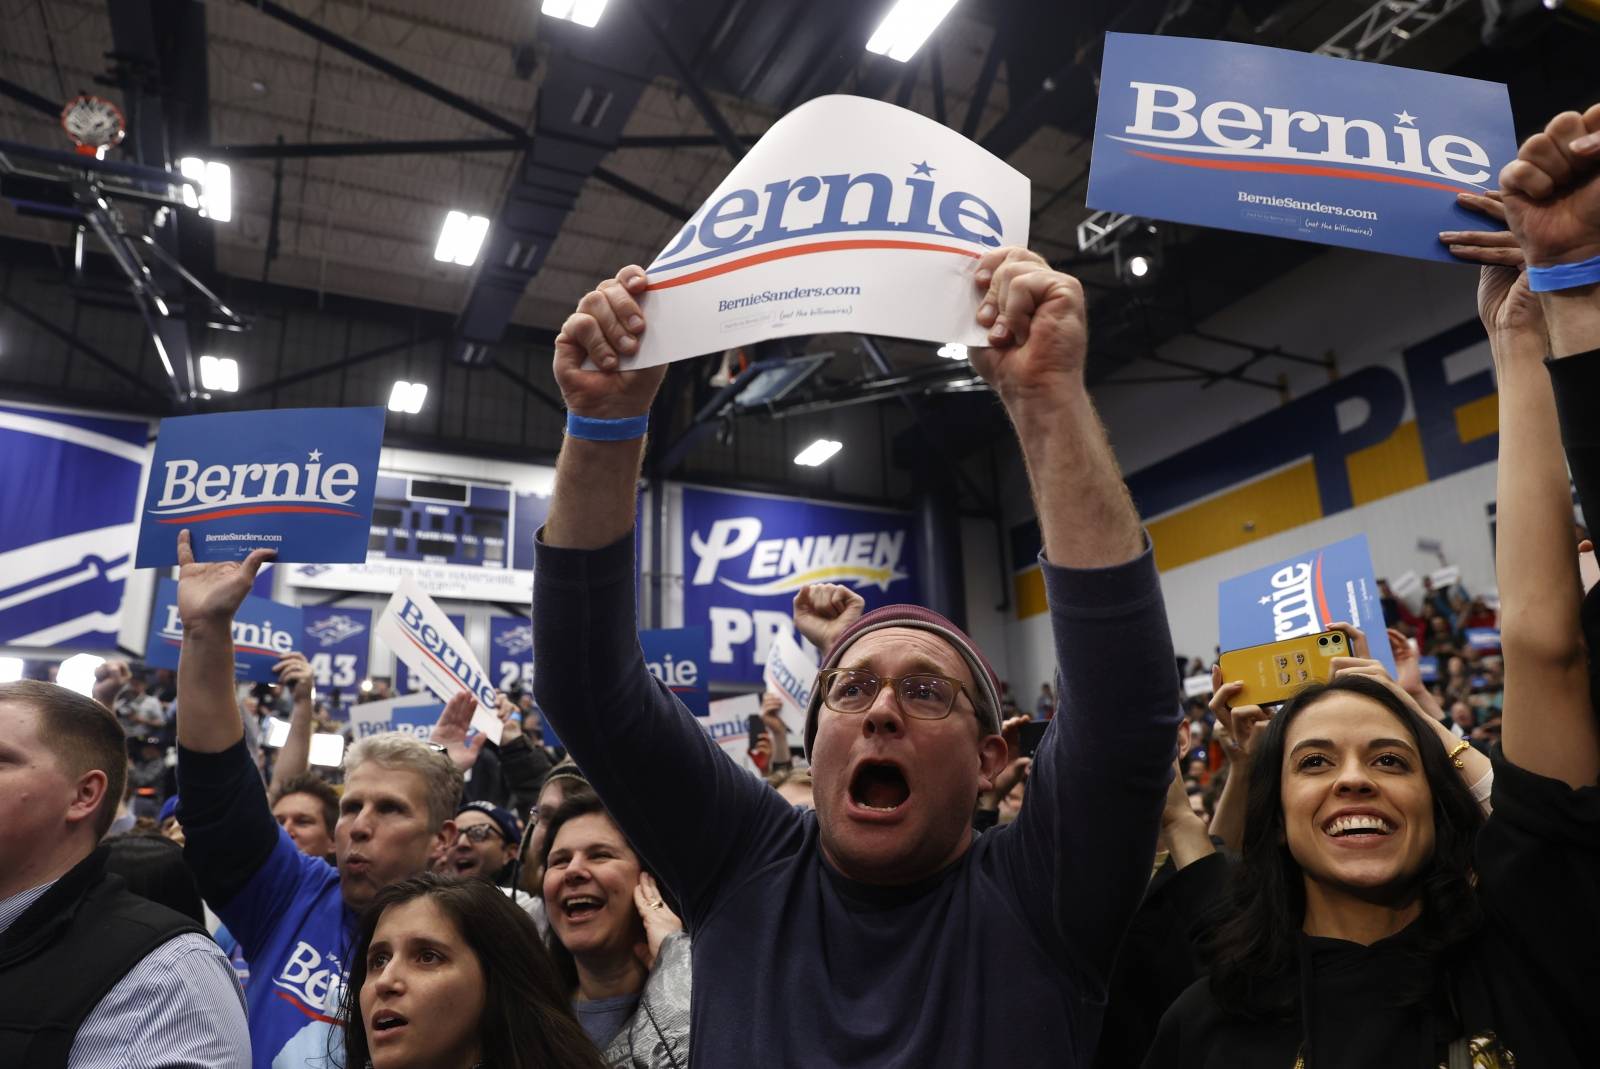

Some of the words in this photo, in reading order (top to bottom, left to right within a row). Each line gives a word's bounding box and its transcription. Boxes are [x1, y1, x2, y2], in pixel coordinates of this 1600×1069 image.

[1124, 80, 1492, 184] Bernie
[656, 159, 1004, 262] ernie
[1237, 190, 1378, 221] BernieSanders.com
[718, 284, 861, 313] BernieSanders.com
[156, 447, 359, 508] Bernie
[205, 532, 283, 543] BernieSanders.com
[690, 516, 905, 586] PENMEN
[314, 652, 358, 687] 43
[399, 596, 498, 710] Bernie
